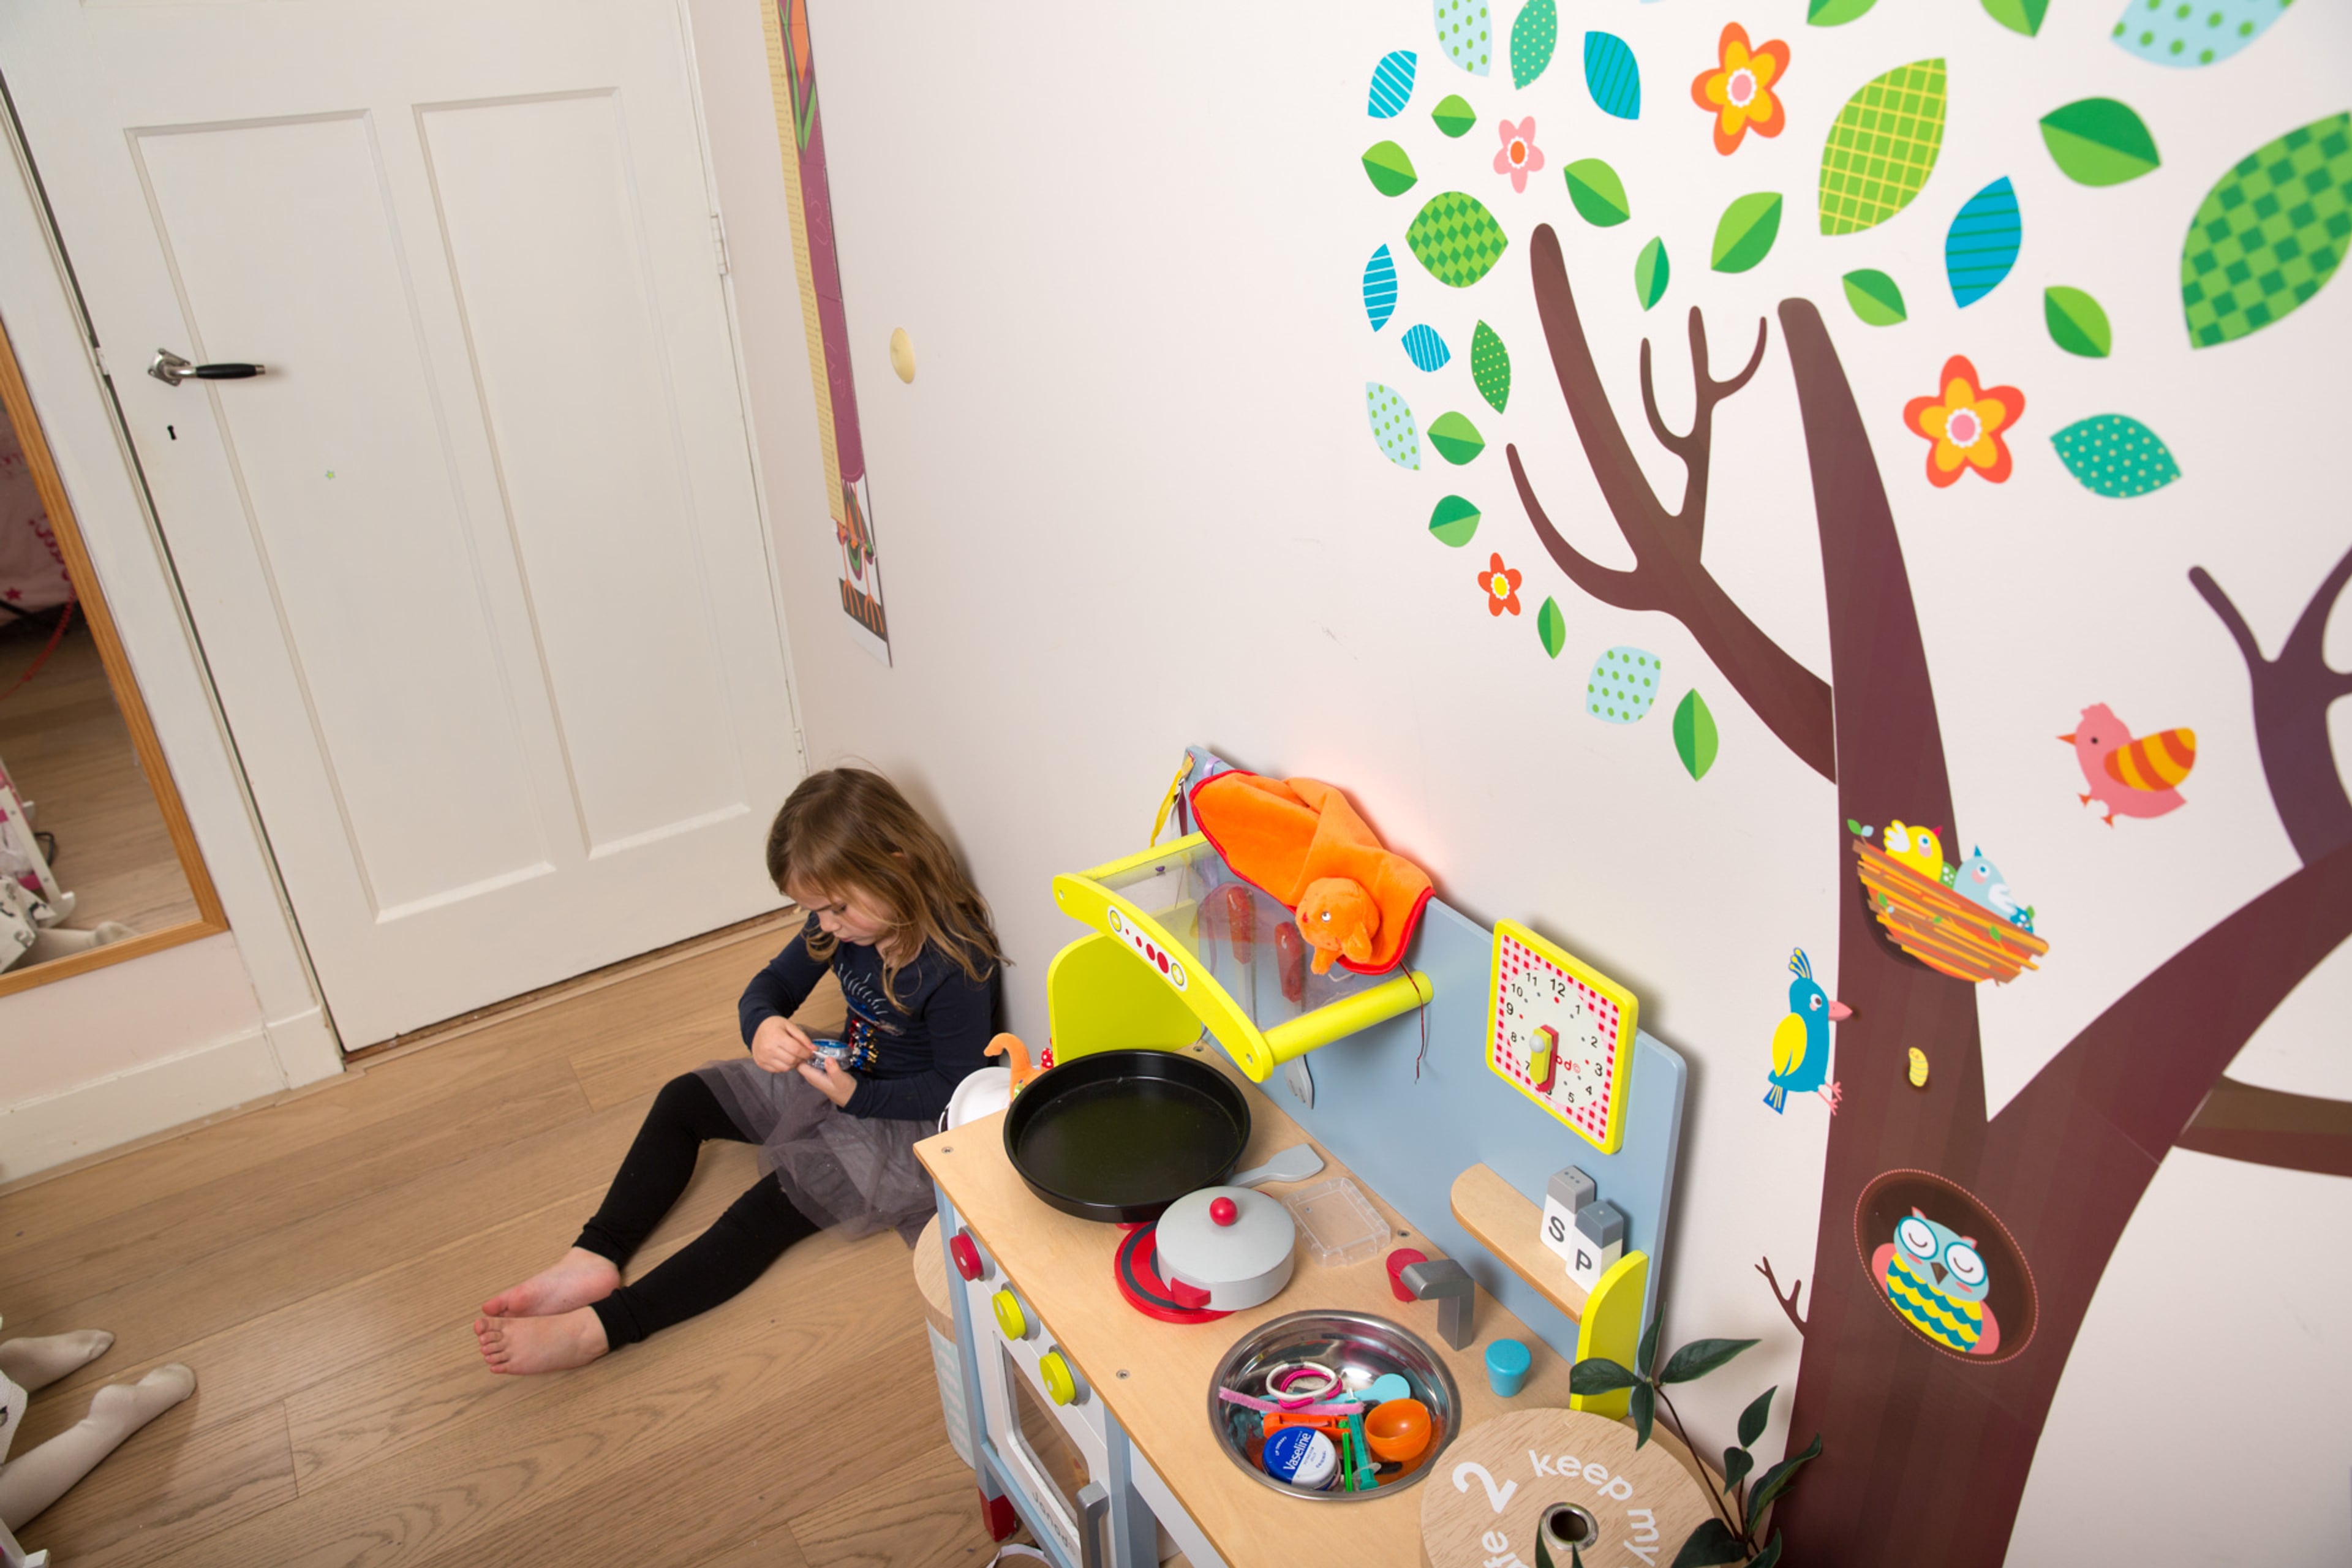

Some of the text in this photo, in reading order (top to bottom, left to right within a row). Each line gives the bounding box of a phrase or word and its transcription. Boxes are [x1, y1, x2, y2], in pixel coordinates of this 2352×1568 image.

[1526, 972, 1537, 987] 11
[1511, 983, 1523, 997] 10
[1550, 978, 1566, 998] 12
[1506, 1001, 1514, 1016] 9
[1575, 1005, 1580, 1015] 1
[1510, 1031, 1517, 1042] 8
[1591, 1036, 1598, 1049] 2
[1525, 1060, 1531, 1071] 7
[1594, 1063, 1603, 1077] 3
[1568, 1091, 1575, 1103] 5
[1585, 1085, 1593, 1096] 4
[1548, 1215, 1566, 1243] S
[1575, 1249, 1593, 1271] P
[1283, 1433, 1311, 1470] Vaseline
[1452, 1461, 1518, 1515] 2
[1528, 1449, 1634, 1501] keep
[1623, 1509, 1660, 1567] my
